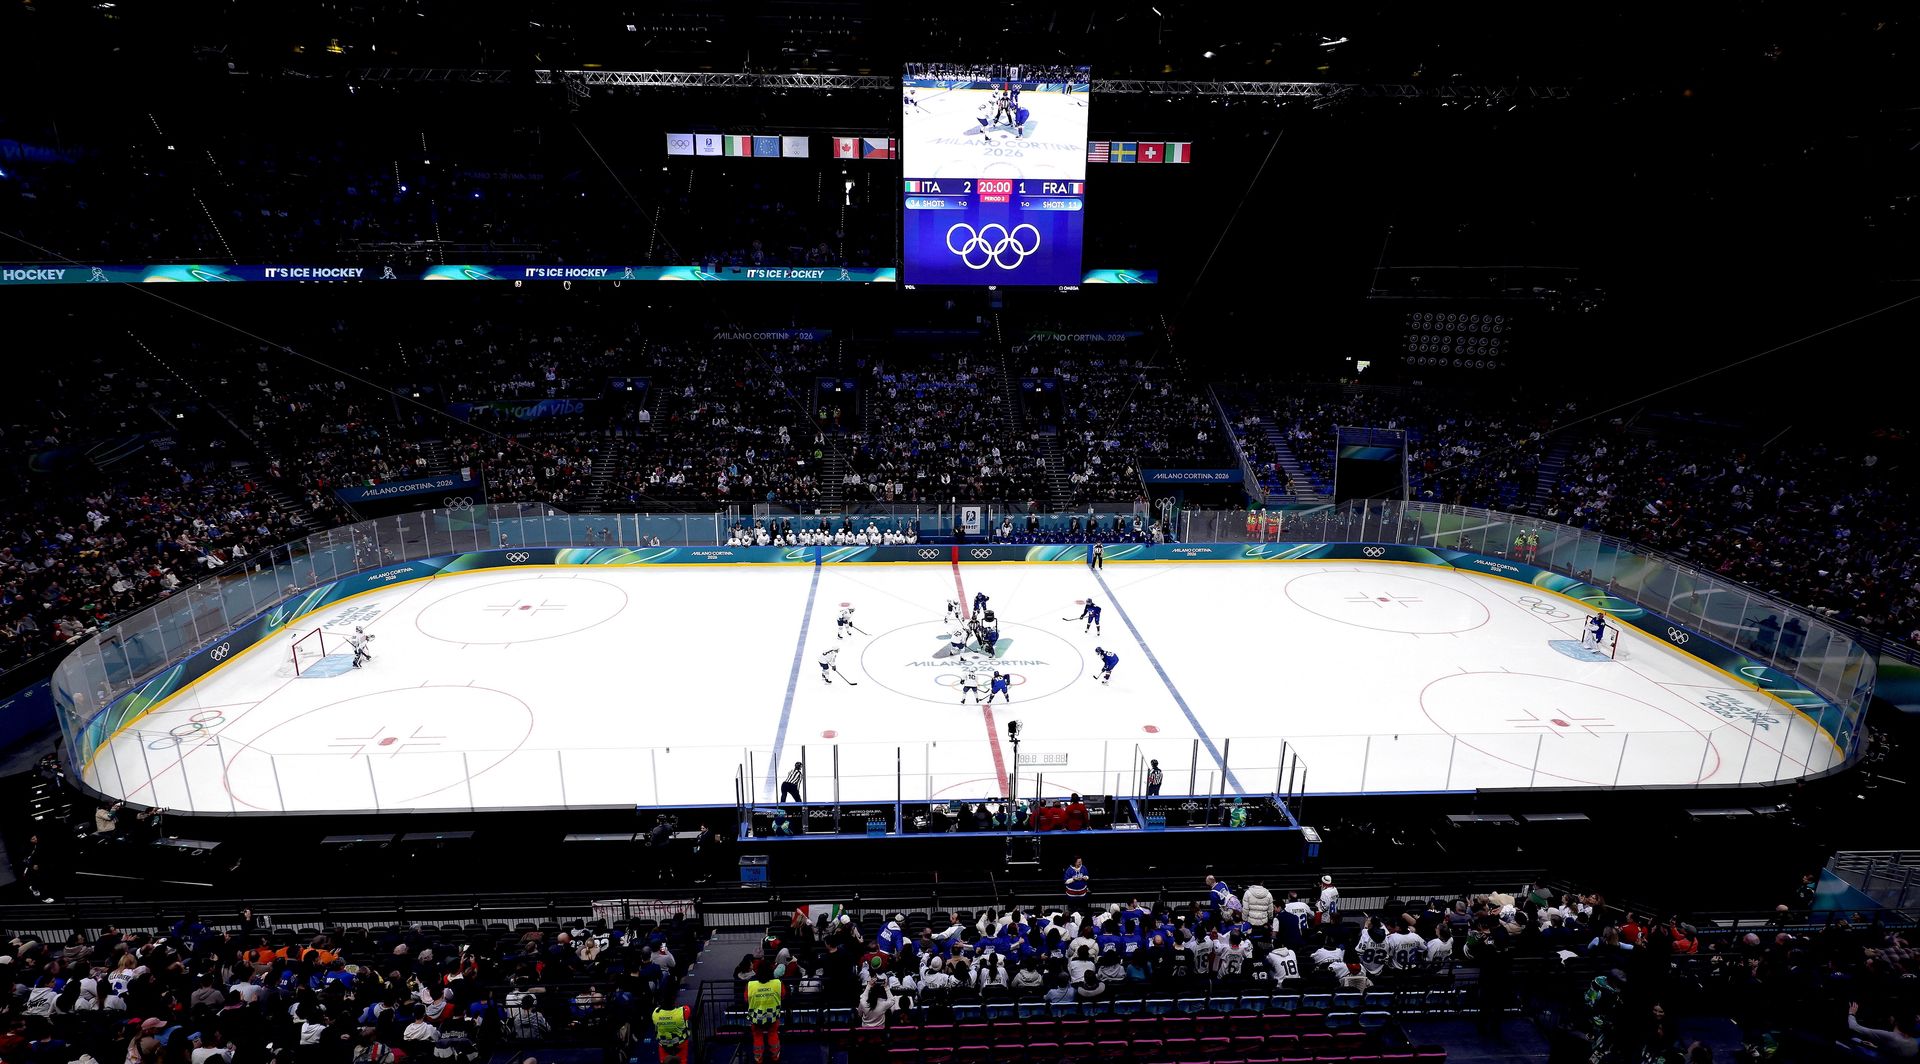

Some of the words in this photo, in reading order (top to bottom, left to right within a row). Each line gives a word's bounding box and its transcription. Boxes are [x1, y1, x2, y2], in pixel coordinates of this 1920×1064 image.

[984, 148, 1024, 157] 2026
[921, 181, 941, 193] ITA
[963, 181, 971, 193] 2
[980, 181, 1010, 193] 20:00
[1019, 182, 1026, 194] 1
[1042, 182, 1068, 194] FRA
[923, 199, 945, 208] SHOTS
[1042, 200, 1065, 208] SHOTS
[3, 269, 66, 281] HOCKEY
[290, 267, 310, 278] ICE
[312, 267, 364, 278] HOCKEY
[546, 268, 564, 277] ICE
[565, 268, 608, 277] HOCKEY
[766, 269, 782, 278] ICE
[712, 332, 752, 341] MILANO
[1107, 334, 1126, 342] 2026
[1153, 472, 1183, 480] MILANO
[1183, 472, 1214, 480] CORTINA
[1214, 472, 1229, 480] 2026
[361, 486, 398, 498] MILANO
[399, 482, 435, 493] CORTINA
[436, 479, 453, 488] 2026
[1363, 949, 1388, 964] 82
[1397, 948, 1418, 965] 82
[1280, 960, 1297, 976] 18
